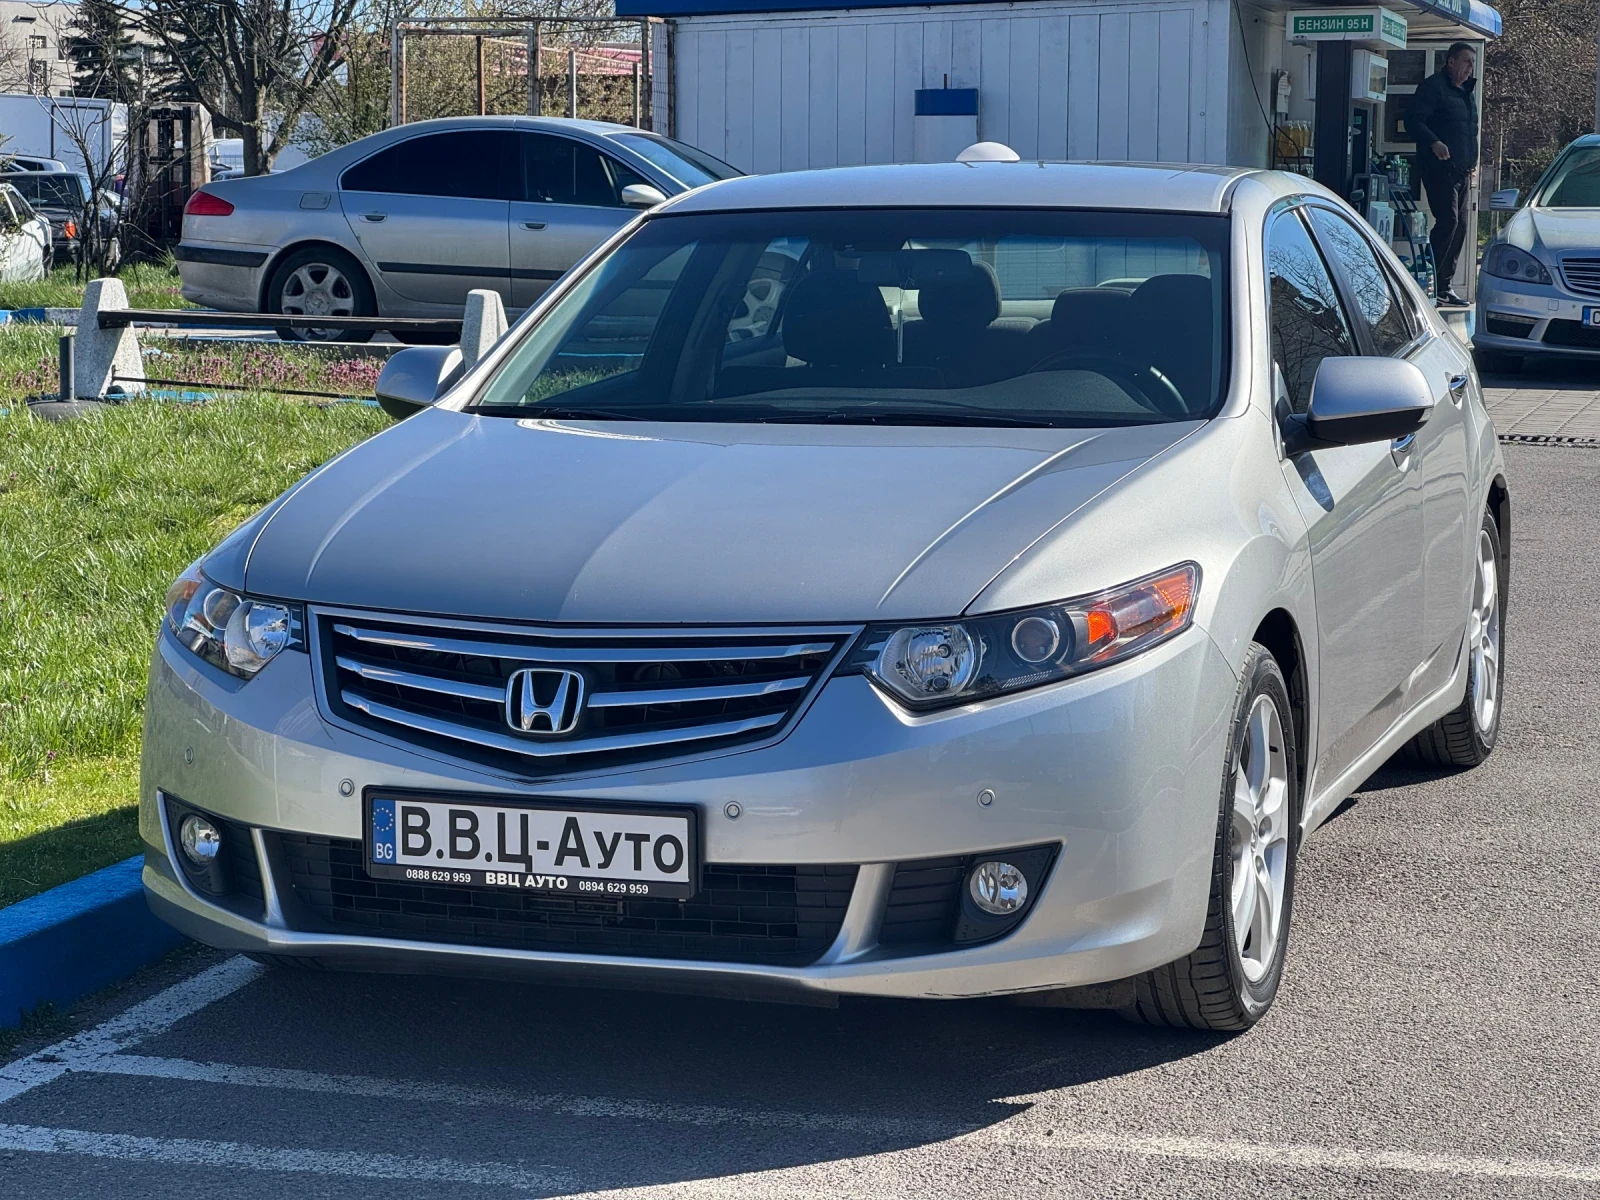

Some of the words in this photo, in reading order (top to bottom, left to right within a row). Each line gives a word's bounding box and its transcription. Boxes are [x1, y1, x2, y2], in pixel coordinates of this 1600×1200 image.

[1298, 19, 1344, 31] БЕНЗИН
[1347, 19, 1360, 30] 95
[401, 806, 684, 874] В.В.Ц-Ауто
[375, 843, 393, 860] BG
[406, 869, 430, 880] 0888
[431, 870, 450, 882] 629
[452, 872, 471, 883] 959
[485, 872, 521, 887] ВВЦ
[524, 875, 568, 889] АУТО
[578, 881, 604, 892] 0894
[607, 882, 627, 893] 629
[629, 884, 649, 894] 959
